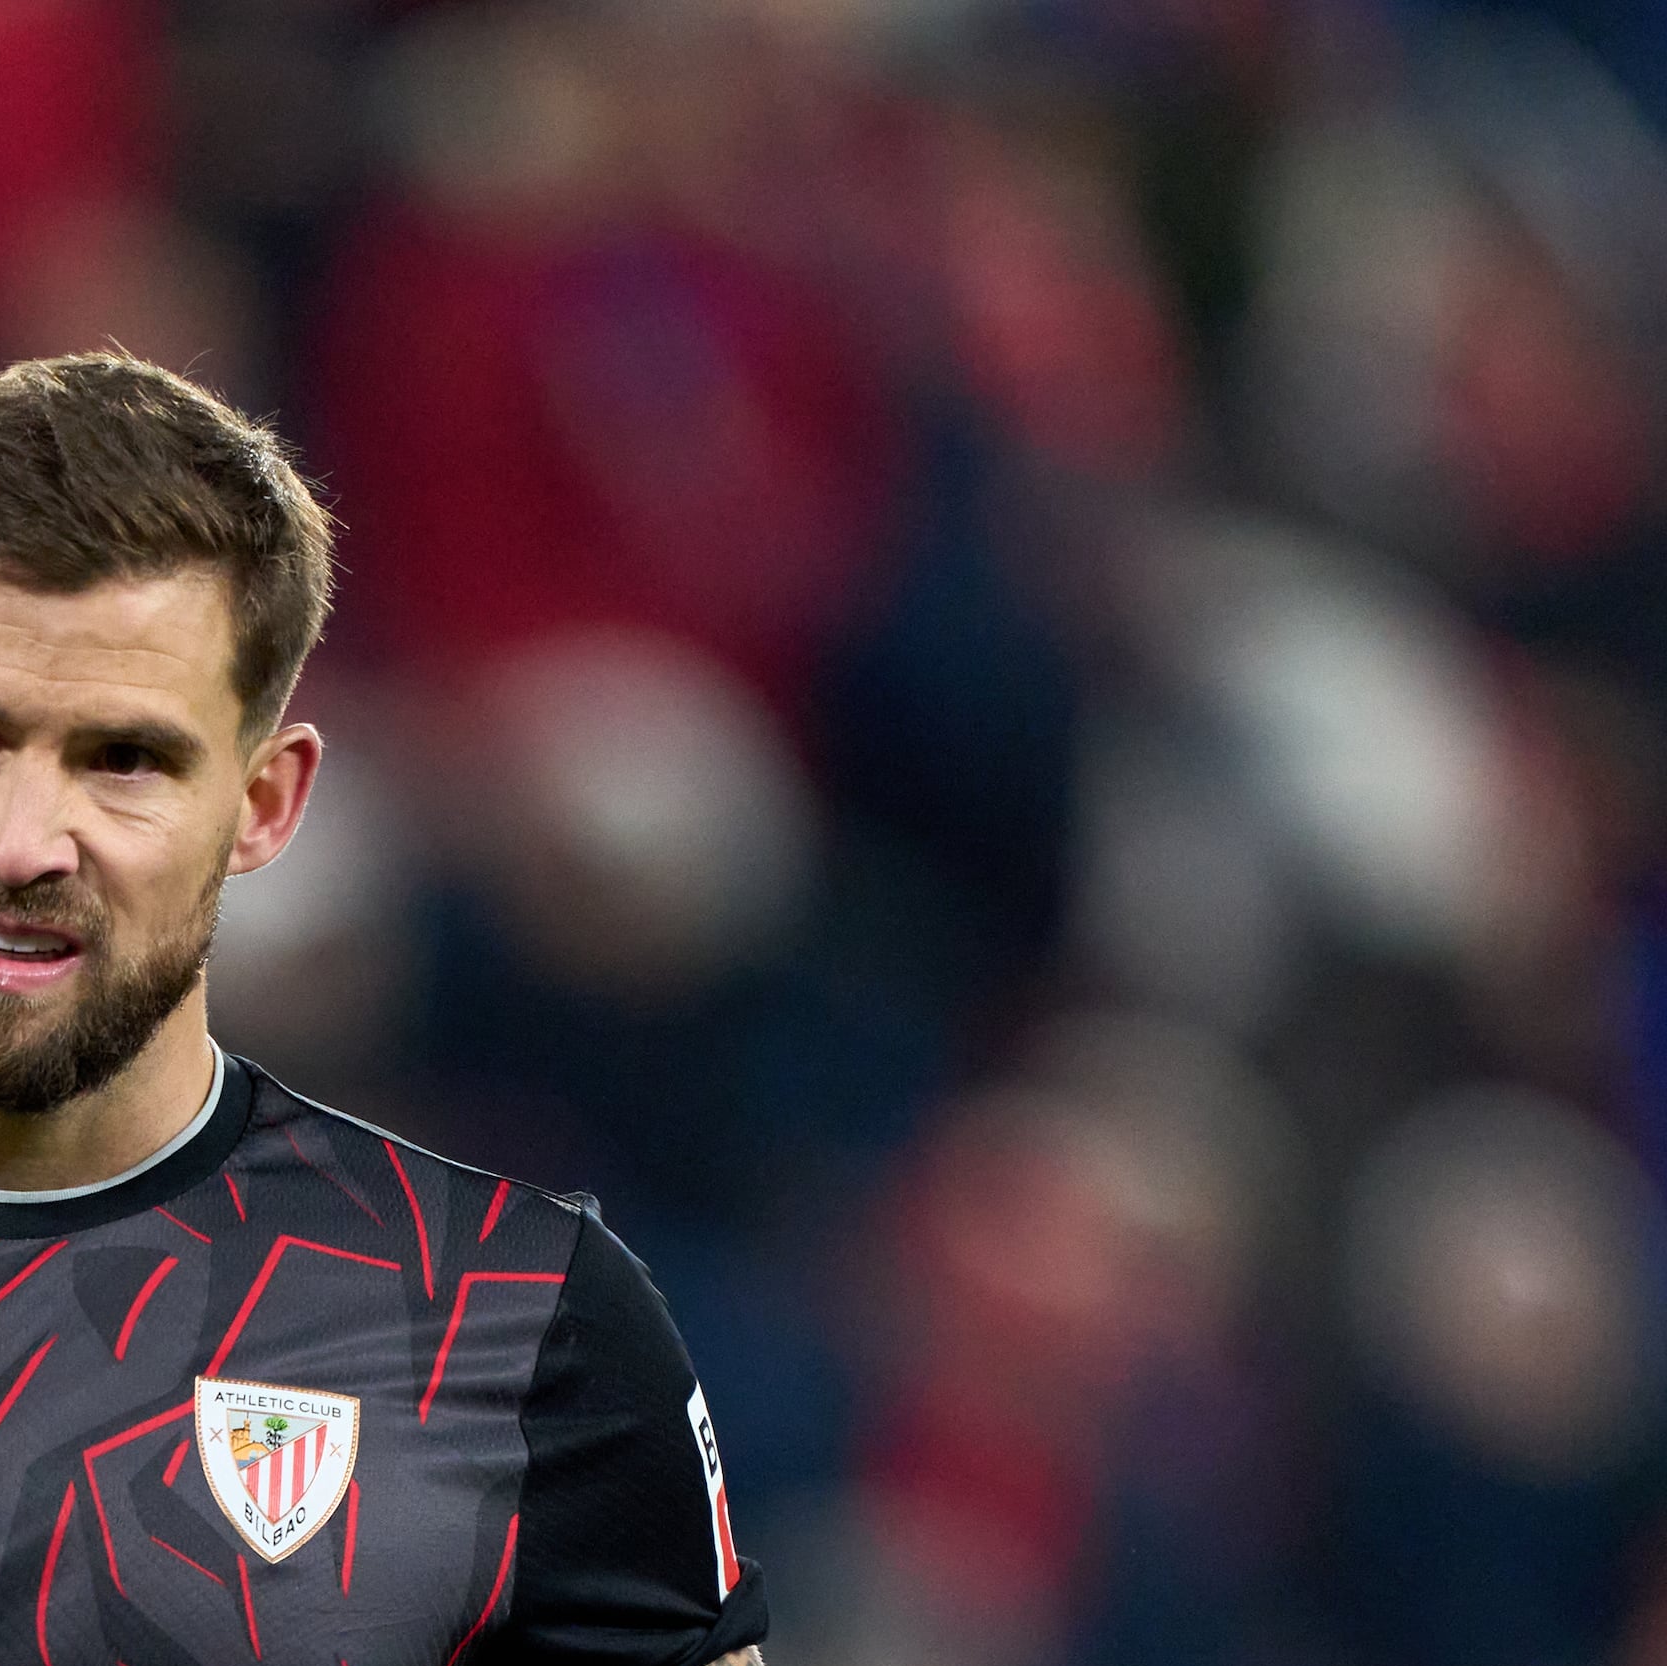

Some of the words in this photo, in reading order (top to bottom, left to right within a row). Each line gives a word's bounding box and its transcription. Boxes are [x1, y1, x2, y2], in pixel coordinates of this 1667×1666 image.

[215, 1391, 295, 1411] ATHLETIC
[299, 1402, 342, 1418] CLUB
[244, 1501, 306, 1547] BILBAO
